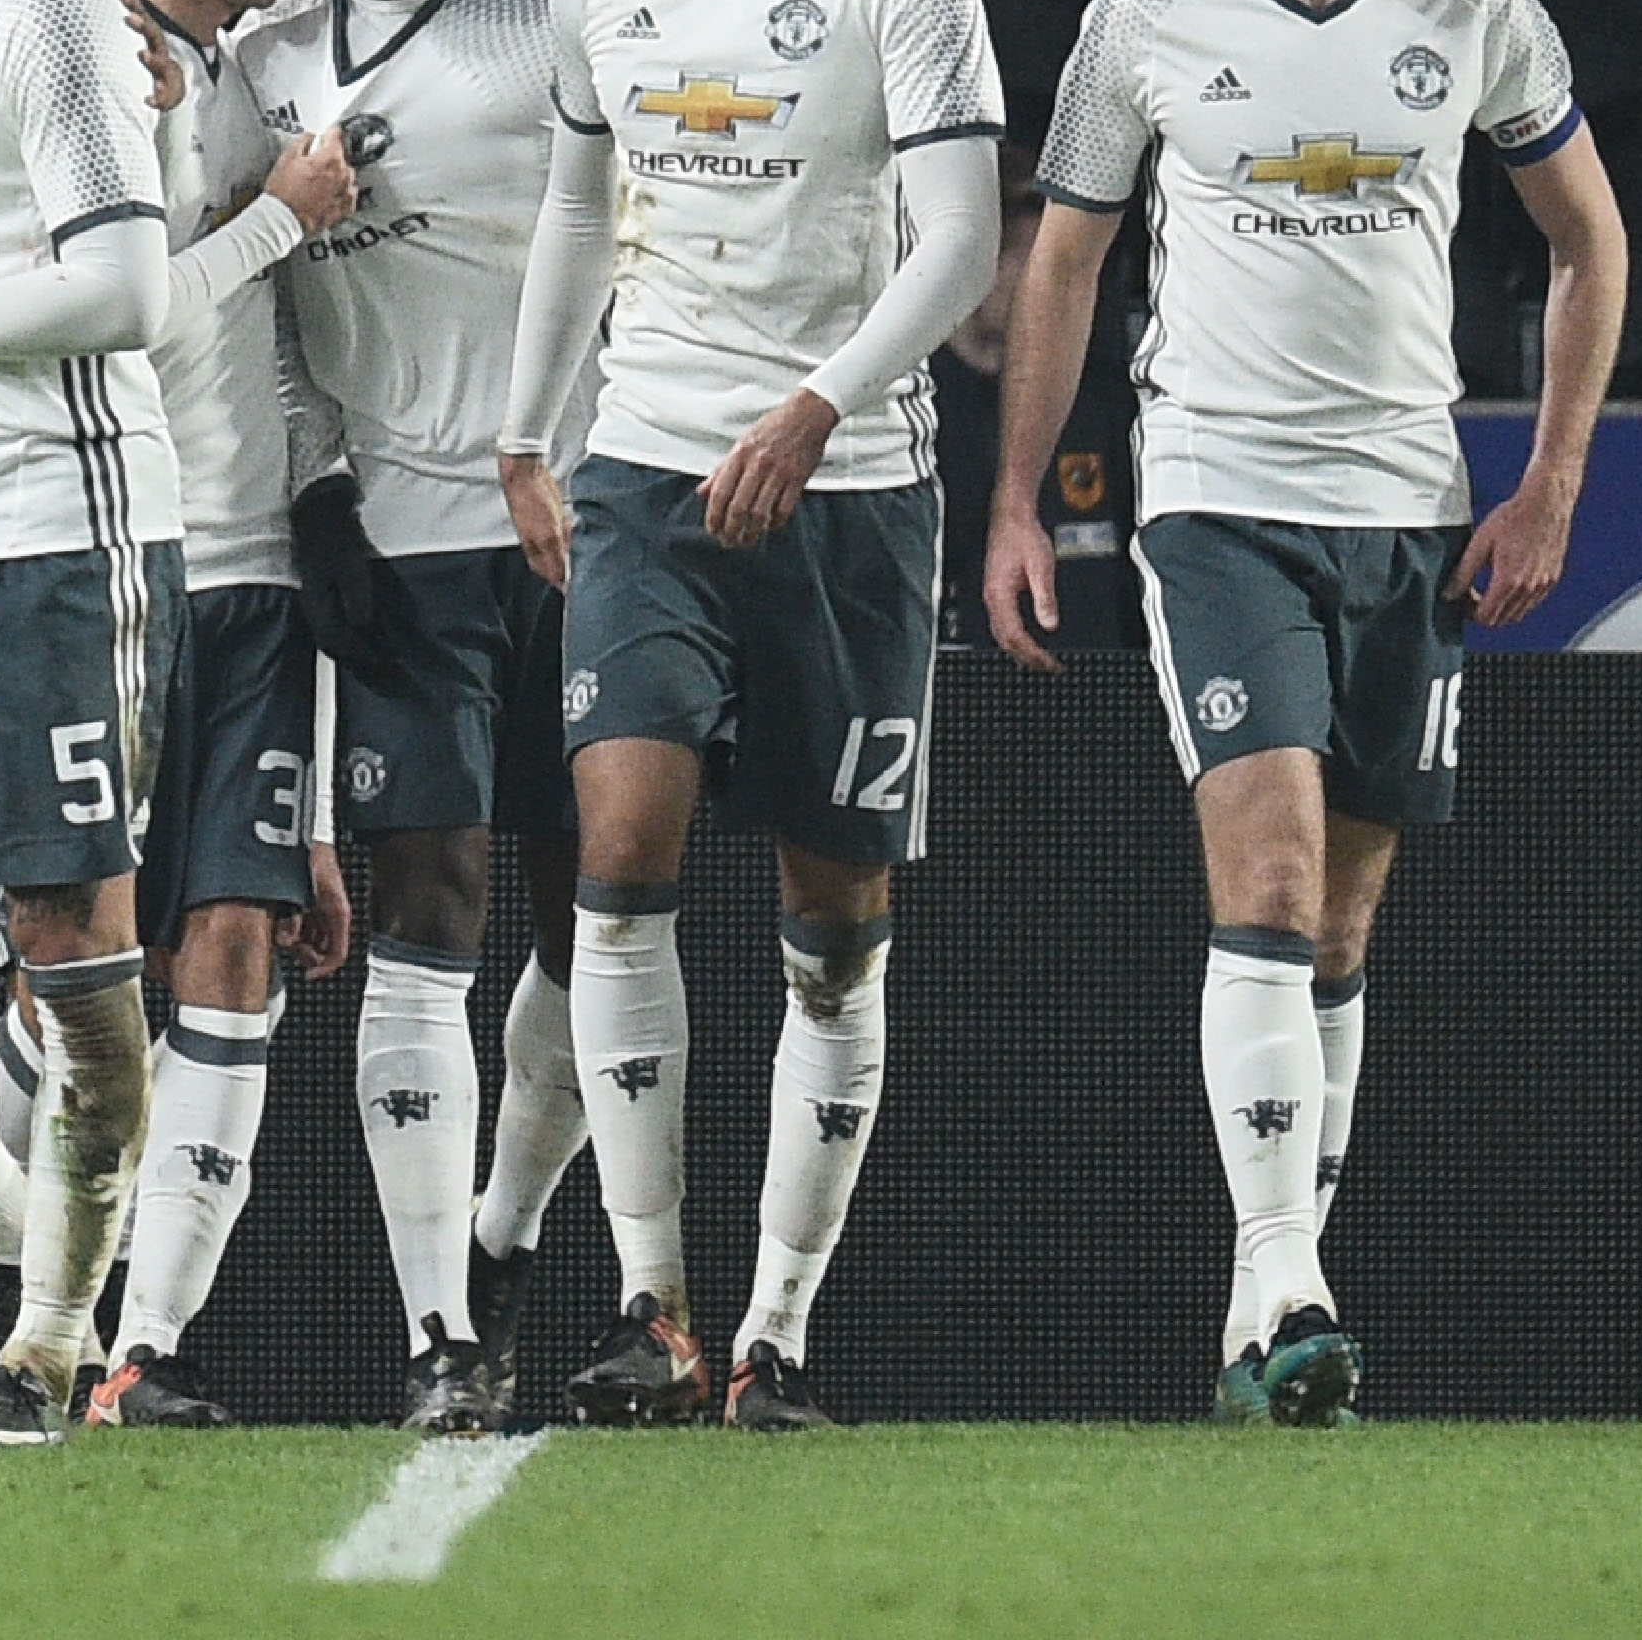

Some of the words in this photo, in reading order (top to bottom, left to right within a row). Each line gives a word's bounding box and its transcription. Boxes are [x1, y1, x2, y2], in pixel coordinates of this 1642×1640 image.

[628, 149, 807, 179] CHEVROLET
[1233, 206, 1424, 237] CHEVROLET
[48, 719, 115, 824] 5
[253, 748, 304, 847] 3
[831, 716, 917, 811] 12
